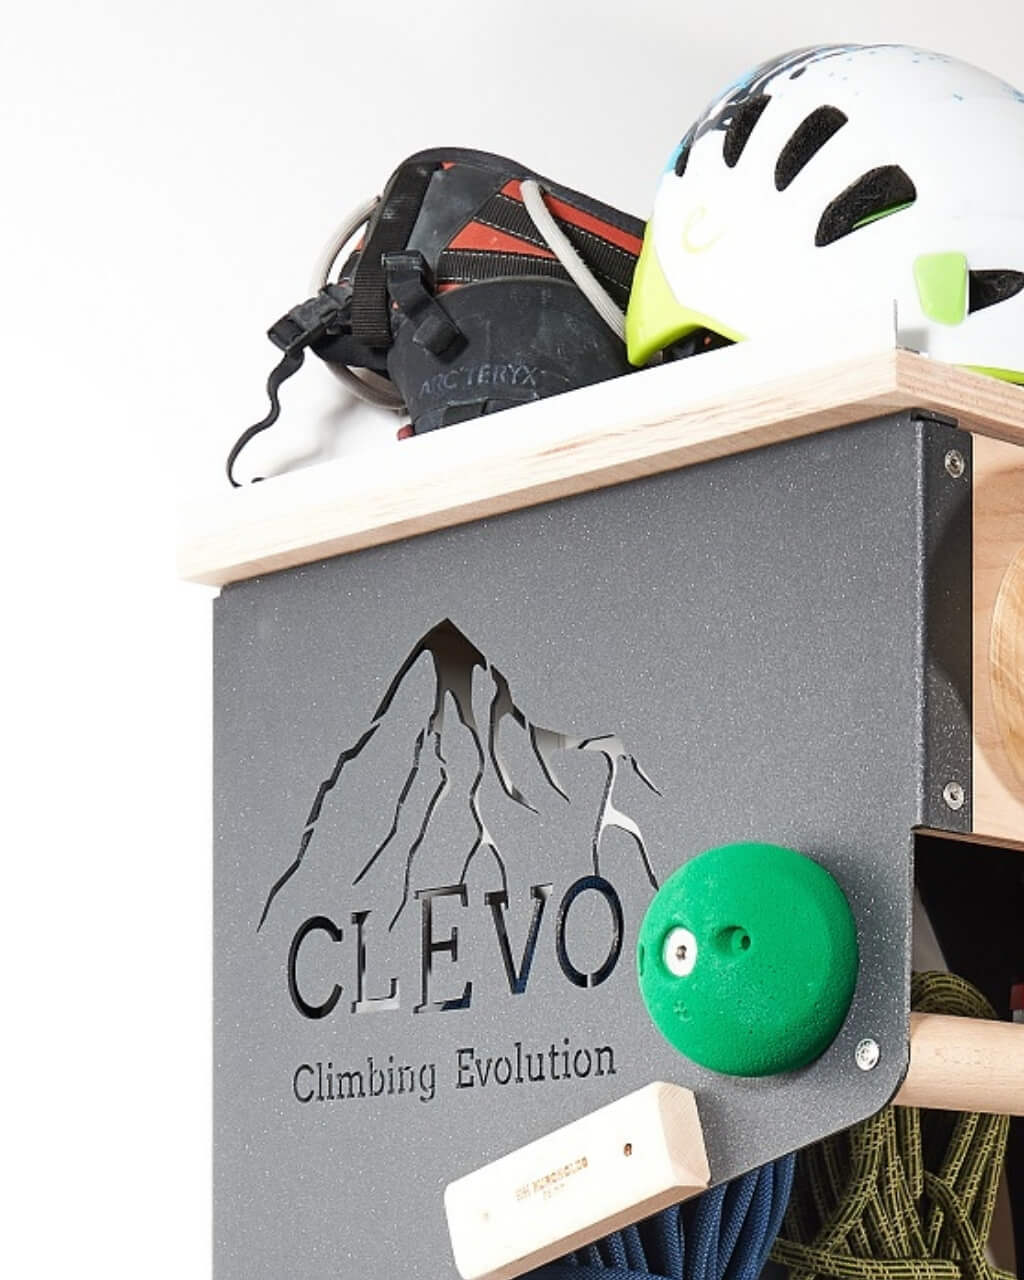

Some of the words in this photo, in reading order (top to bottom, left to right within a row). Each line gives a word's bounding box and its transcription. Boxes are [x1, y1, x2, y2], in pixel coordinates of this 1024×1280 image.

[288, 874, 625, 1020] CLEVO
[292, 1055, 436, 1103] Climbing
[455, 1038, 617, 1090] Evolution
